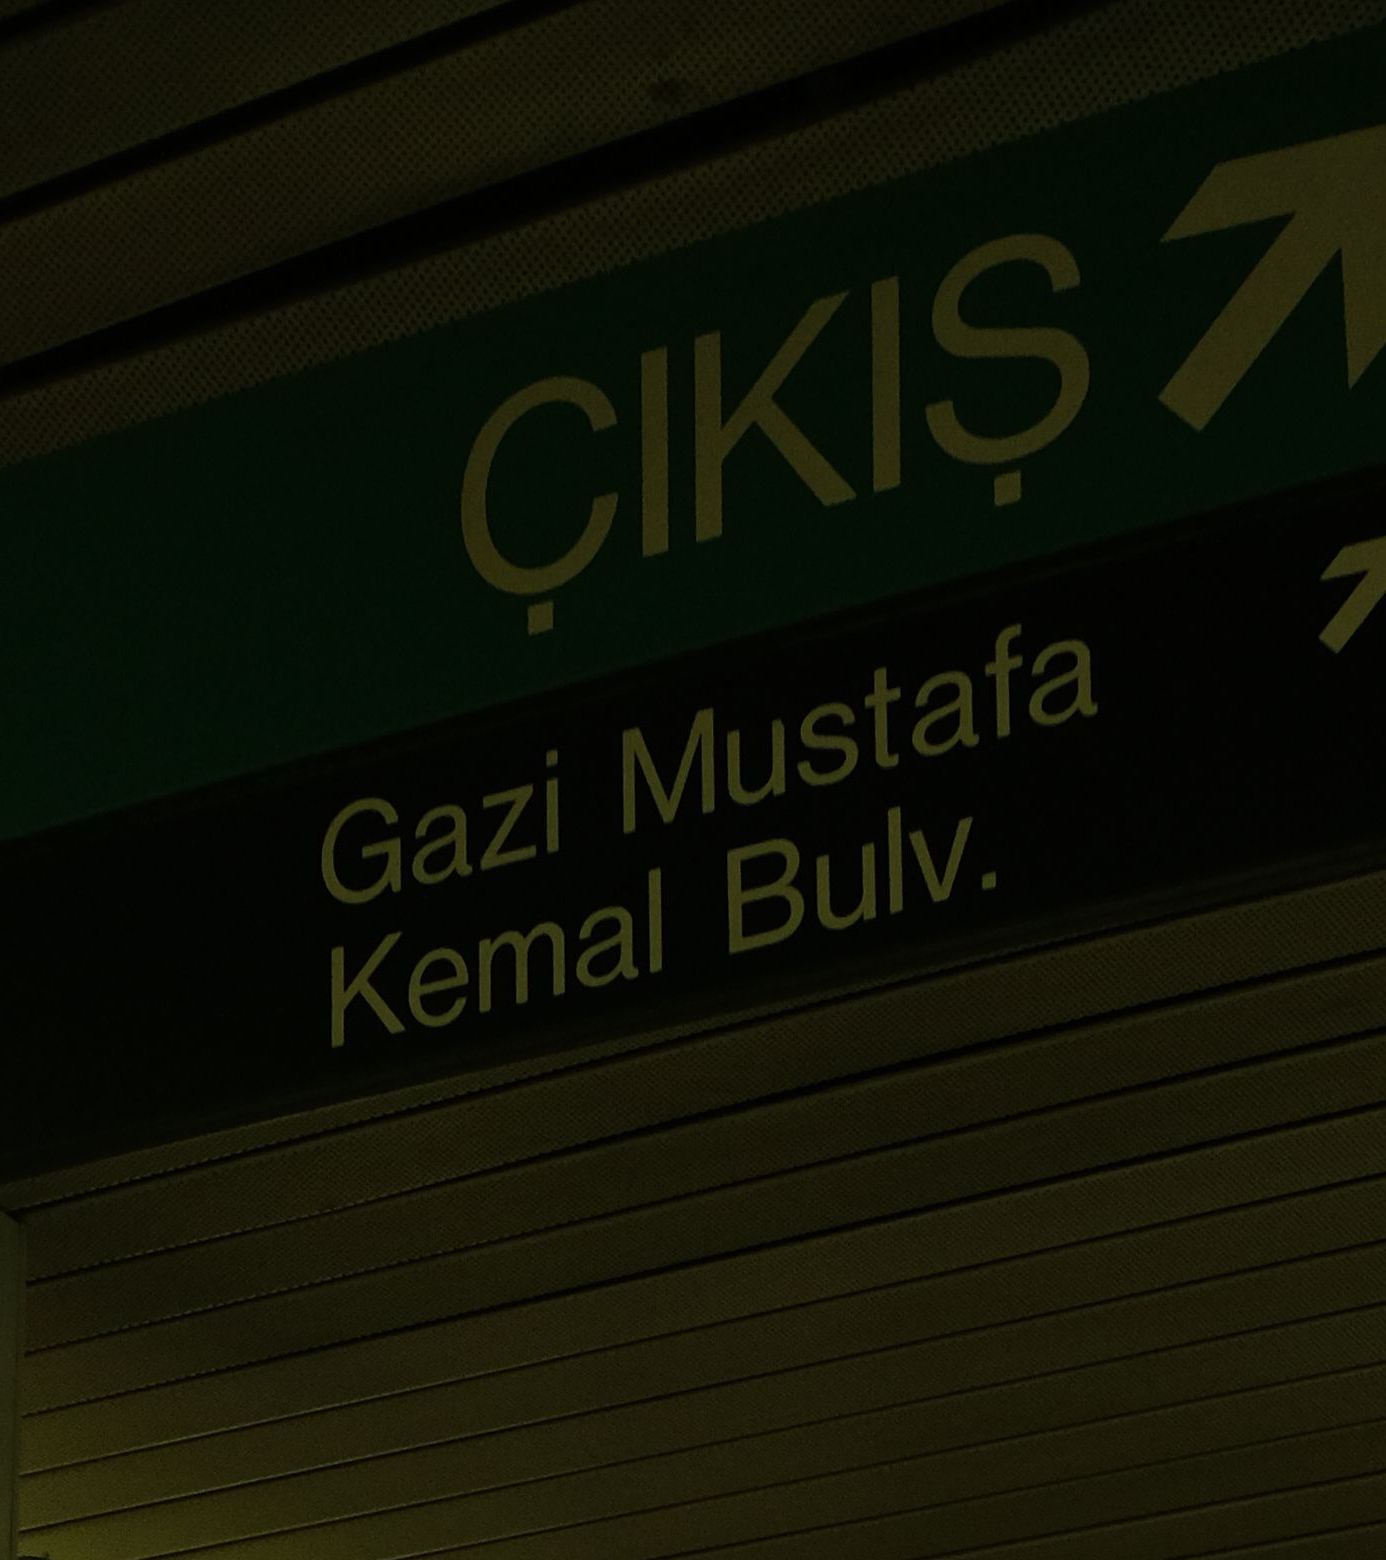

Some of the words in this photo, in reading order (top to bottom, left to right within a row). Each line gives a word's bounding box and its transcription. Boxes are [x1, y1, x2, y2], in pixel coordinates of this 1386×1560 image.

[458, 232, 1092, 637] ÇIKIŞ
[319, 748, 561, 906] Gazi
[620, 622, 1099, 835] Mustafa
[329, 867, 663, 1048] Kemal
[725, 804, 999, 955] Bulv.
